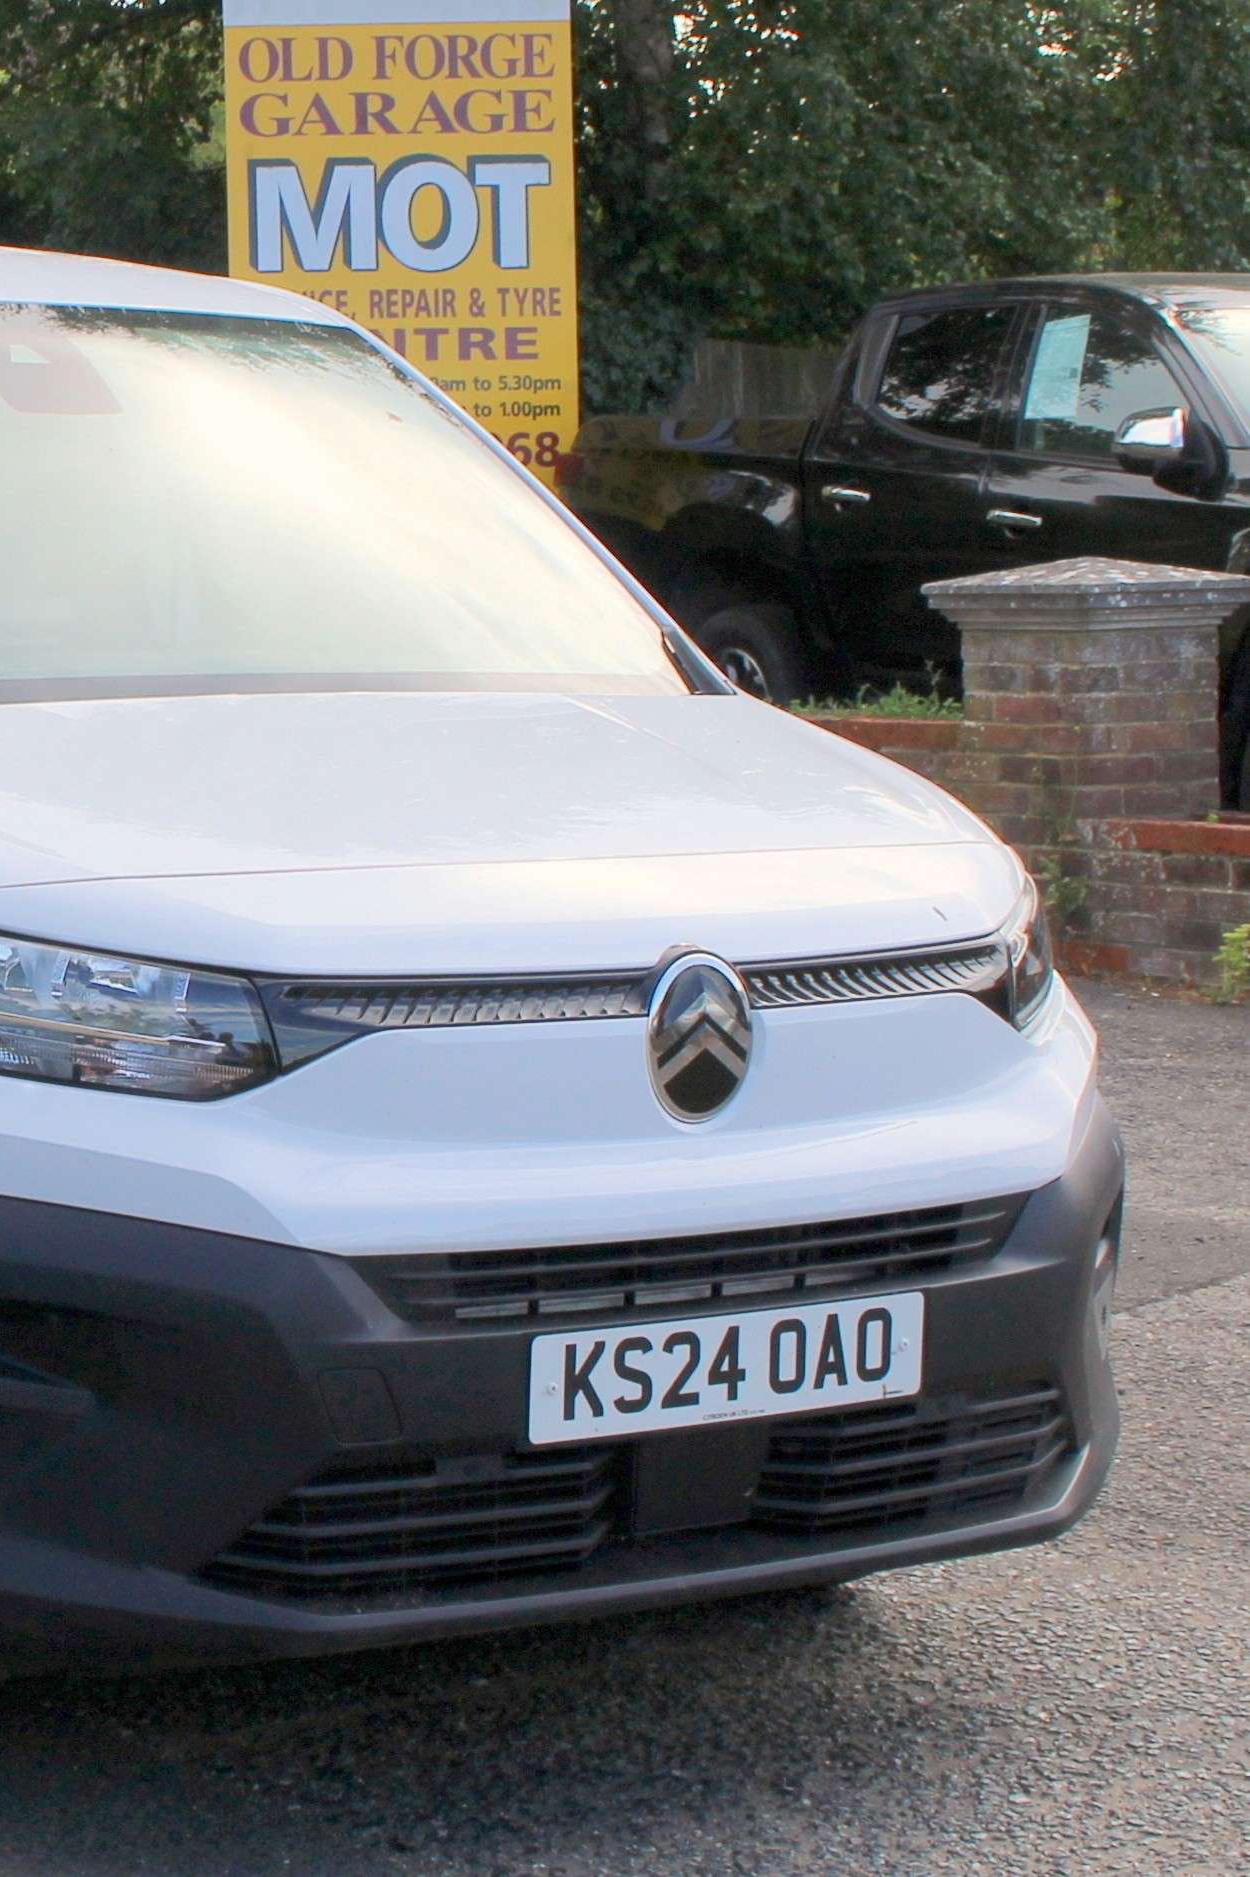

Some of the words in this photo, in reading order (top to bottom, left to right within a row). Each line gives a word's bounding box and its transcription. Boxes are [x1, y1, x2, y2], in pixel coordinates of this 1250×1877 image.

[239, 36, 353, 83] OLD
[371, 33, 556, 81] FORGE
[239, 89, 556, 138] GARAGE
[247, 153, 551, 273] MOT
[369, 287, 457, 319] REPAIR
[468, 288, 486, 318] &
[496, 287, 562, 317] TYRE
[473, 376, 492, 391] to
[498, 375, 562, 394] 5.30pm
[473, 402, 492, 417] to
[499, 401, 561, 420] 1.00pm
[562, 1325, 746, 1421] KS24
[768, 1306, 892, 1395] OAO
